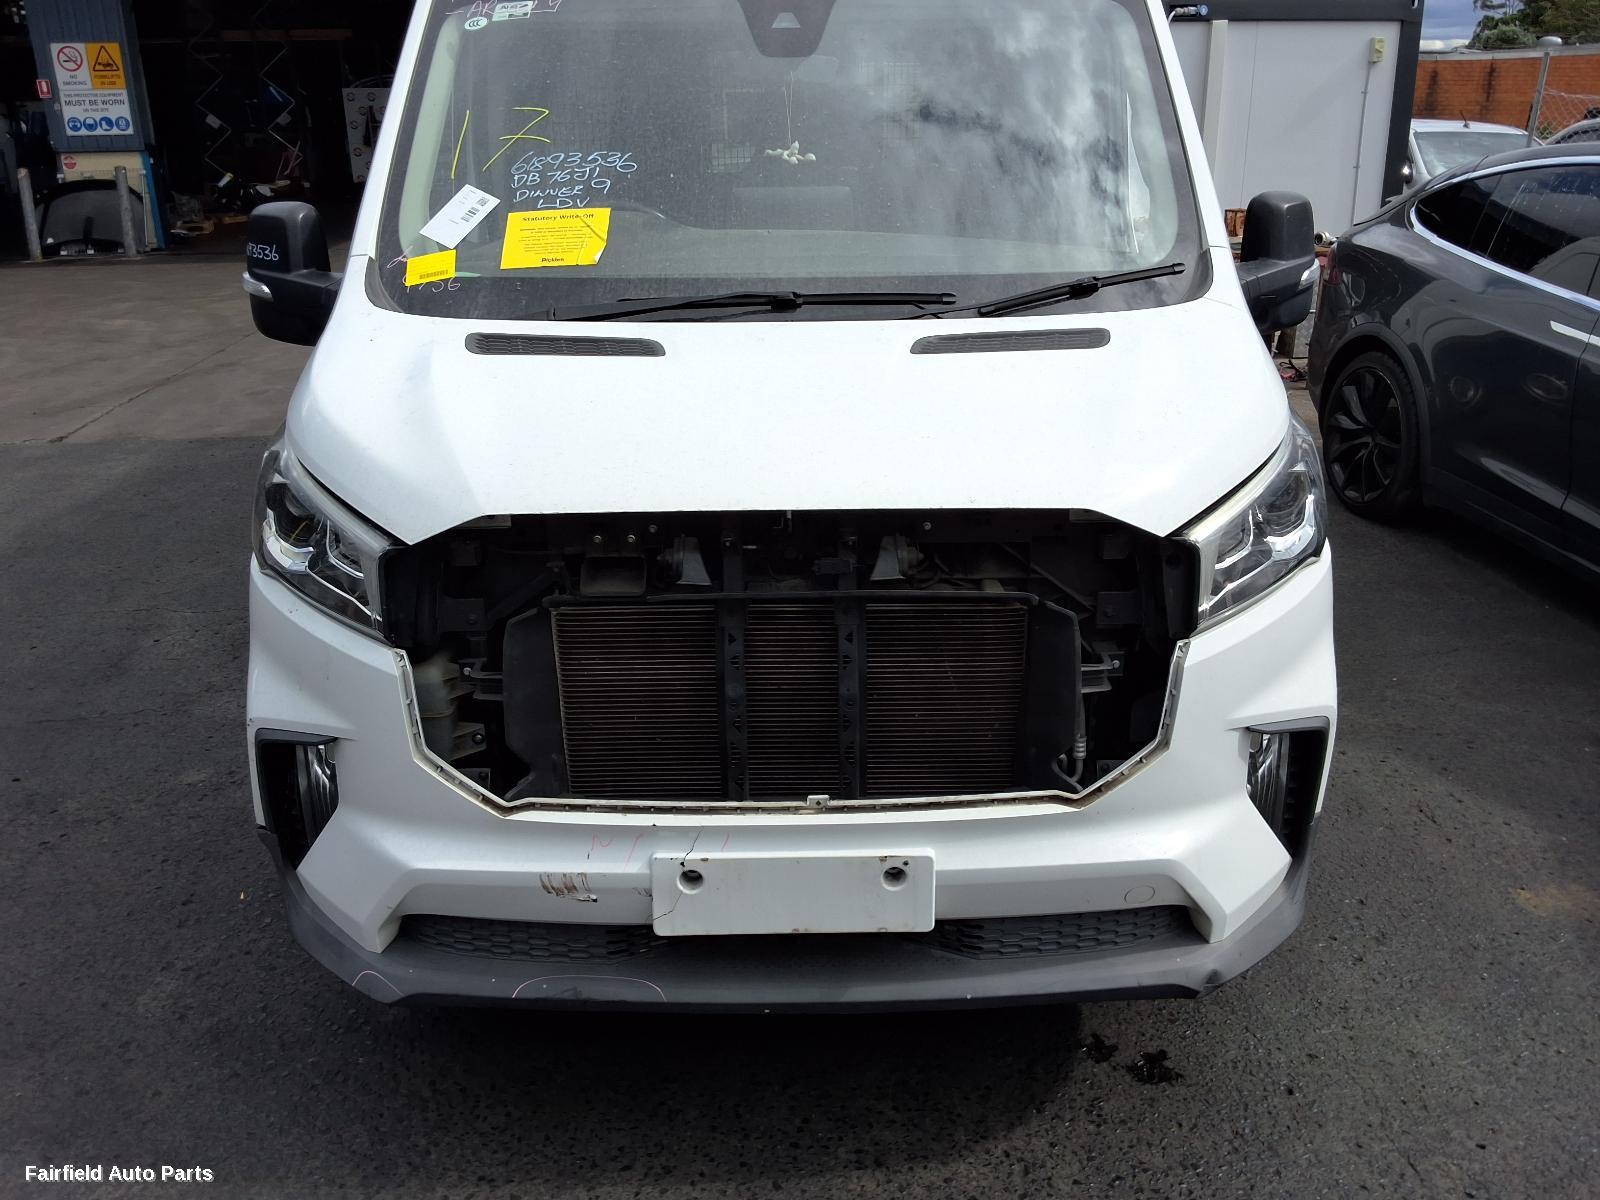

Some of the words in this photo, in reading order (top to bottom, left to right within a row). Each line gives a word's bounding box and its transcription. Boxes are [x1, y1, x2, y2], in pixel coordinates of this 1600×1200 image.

[64, 99, 86, 107] MUST
[511, 172, 541, 188] DB
[537, 196, 590, 209] LDV
